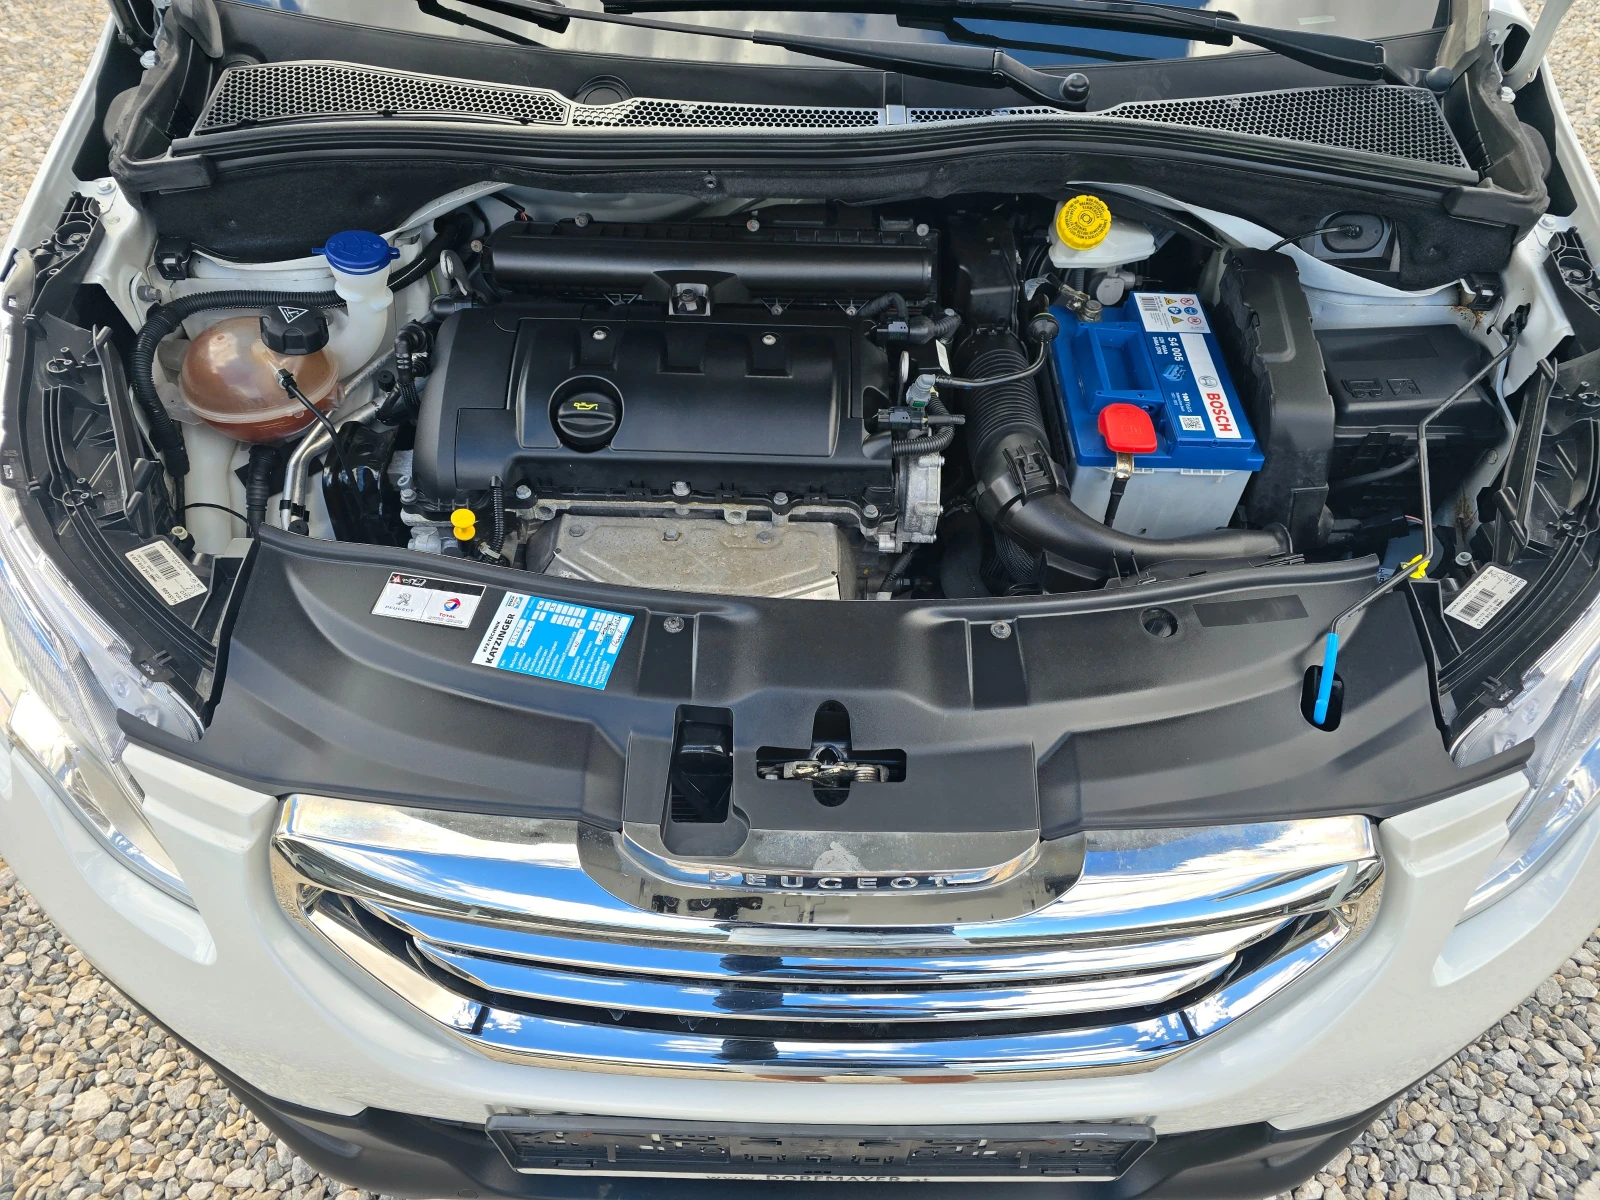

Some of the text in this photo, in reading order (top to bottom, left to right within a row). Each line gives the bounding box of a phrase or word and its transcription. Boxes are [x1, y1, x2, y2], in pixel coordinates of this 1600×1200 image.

[1168, 336, 1184, 361] S4 005
[1206, 393, 1233, 431] BOSCH
[385, 605, 414, 613] PEUGEOT
[484, 613, 516, 664] KATZINGER
[709, 870, 953, 889] PEUGEOT
